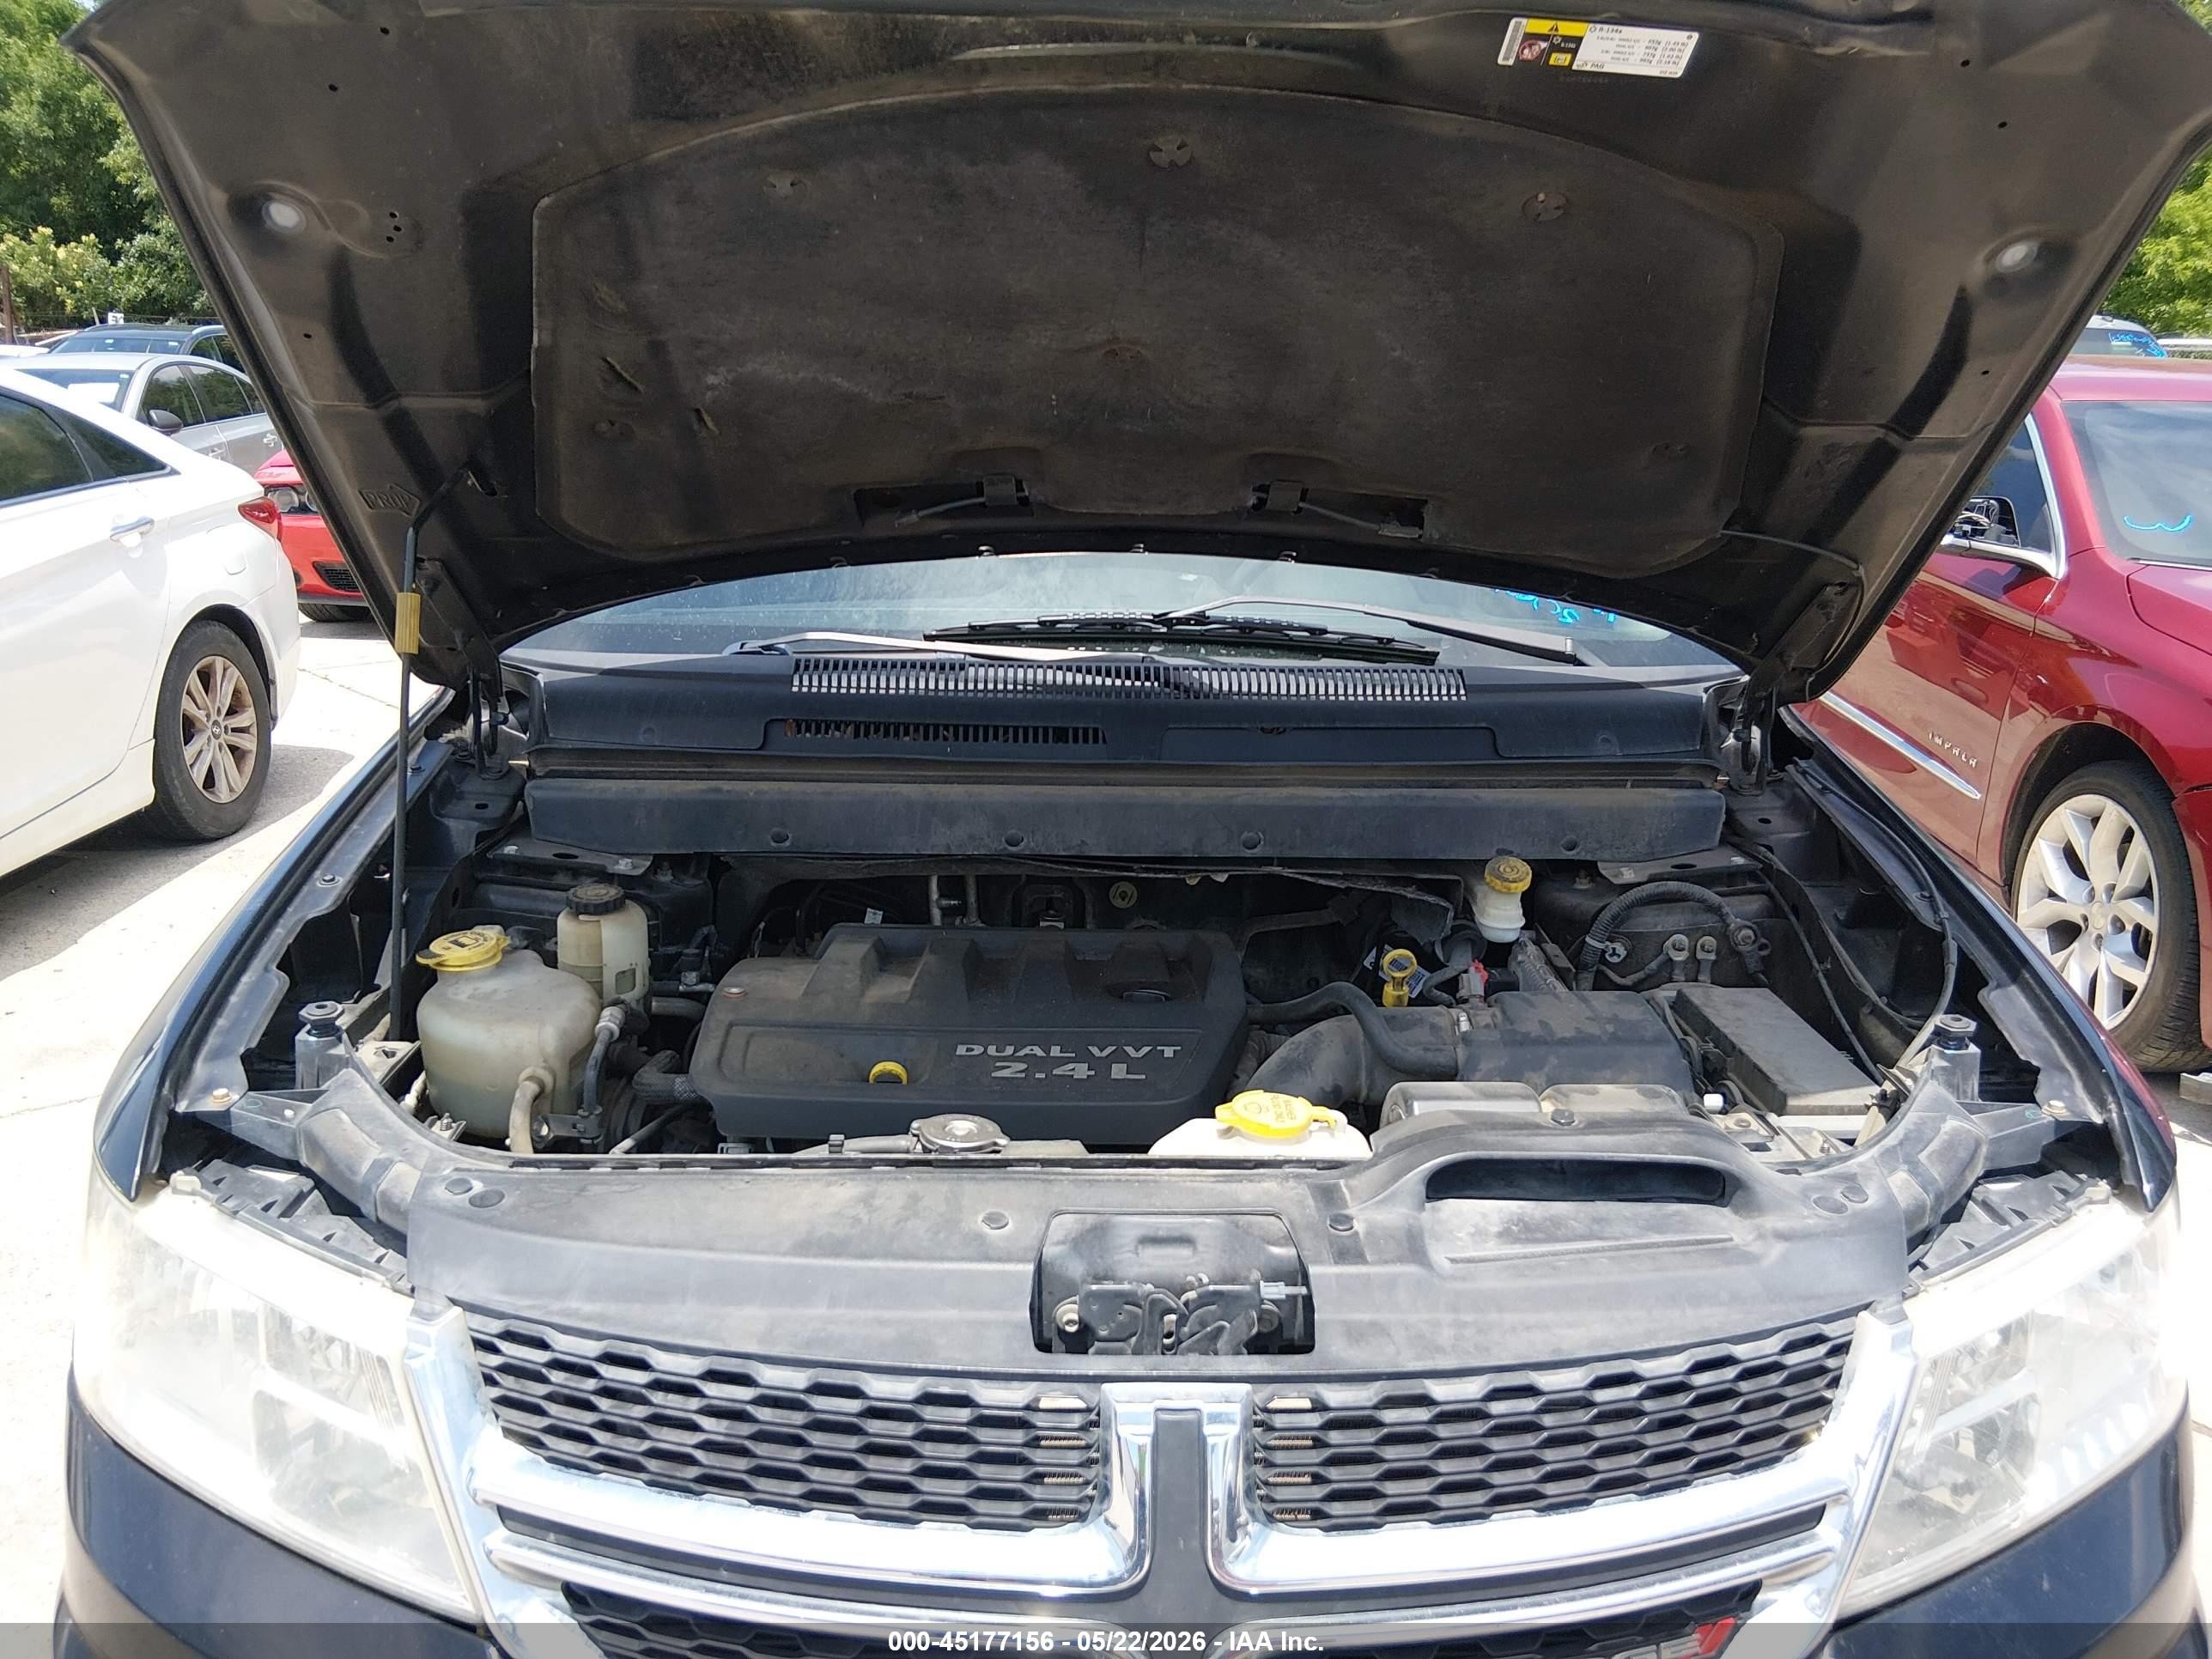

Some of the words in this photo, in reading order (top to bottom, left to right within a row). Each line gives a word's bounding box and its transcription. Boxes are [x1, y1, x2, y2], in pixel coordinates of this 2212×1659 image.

[363, 492, 412, 509] PROP
[1929, 731, 1978, 768] IMPALA
[955, 1044, 1076, 1057] DUAL
[1087, 1045, 1182, 1058] VVT
